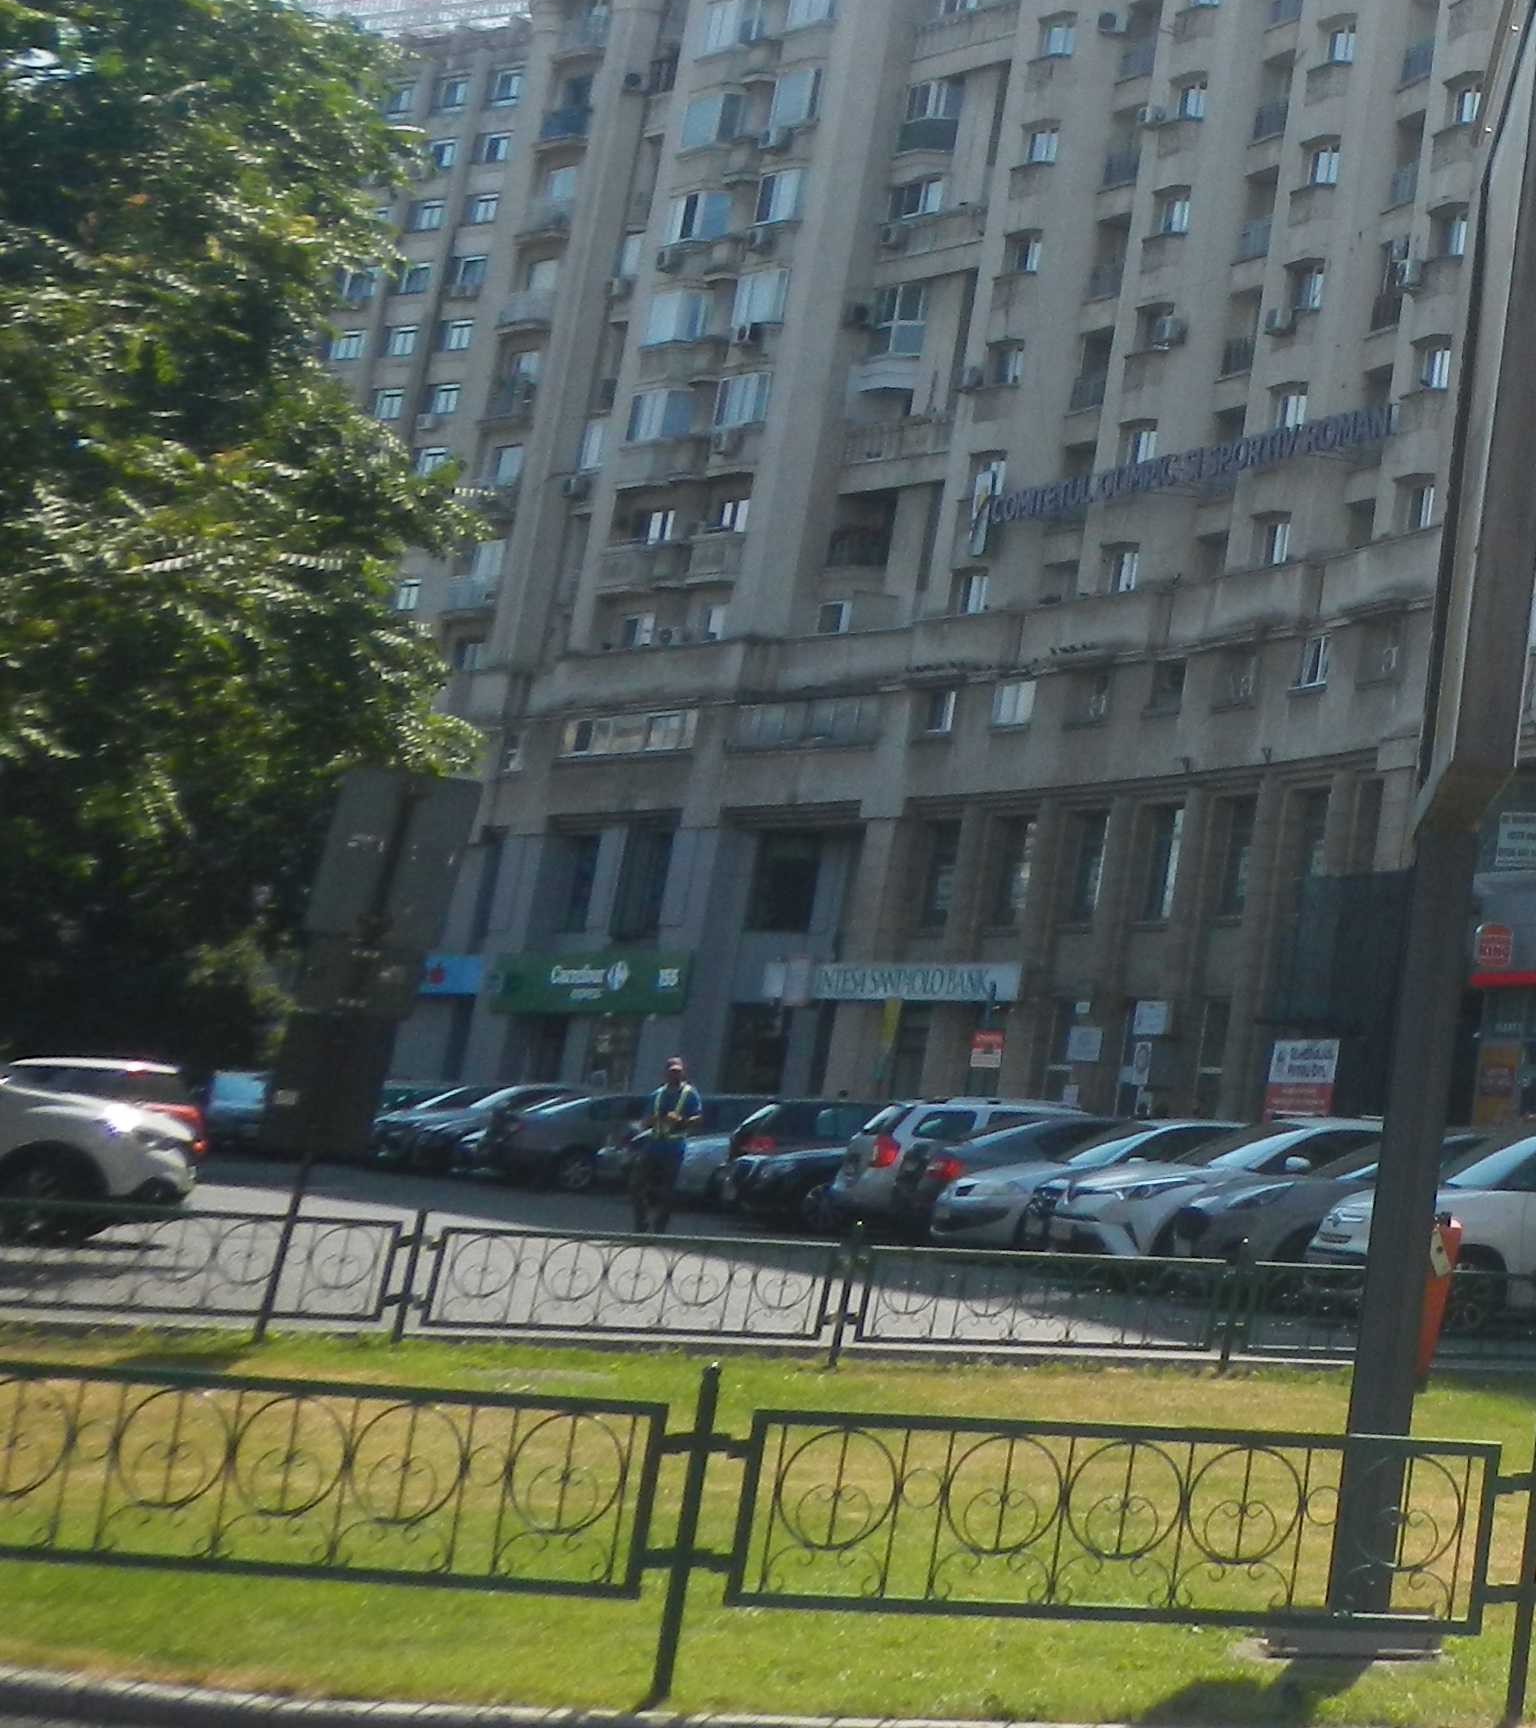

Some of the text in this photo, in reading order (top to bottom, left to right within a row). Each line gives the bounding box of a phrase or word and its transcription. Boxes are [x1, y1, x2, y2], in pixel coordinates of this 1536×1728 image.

[814, 967, 989, 994] INTESA SANPAOLO BANK
